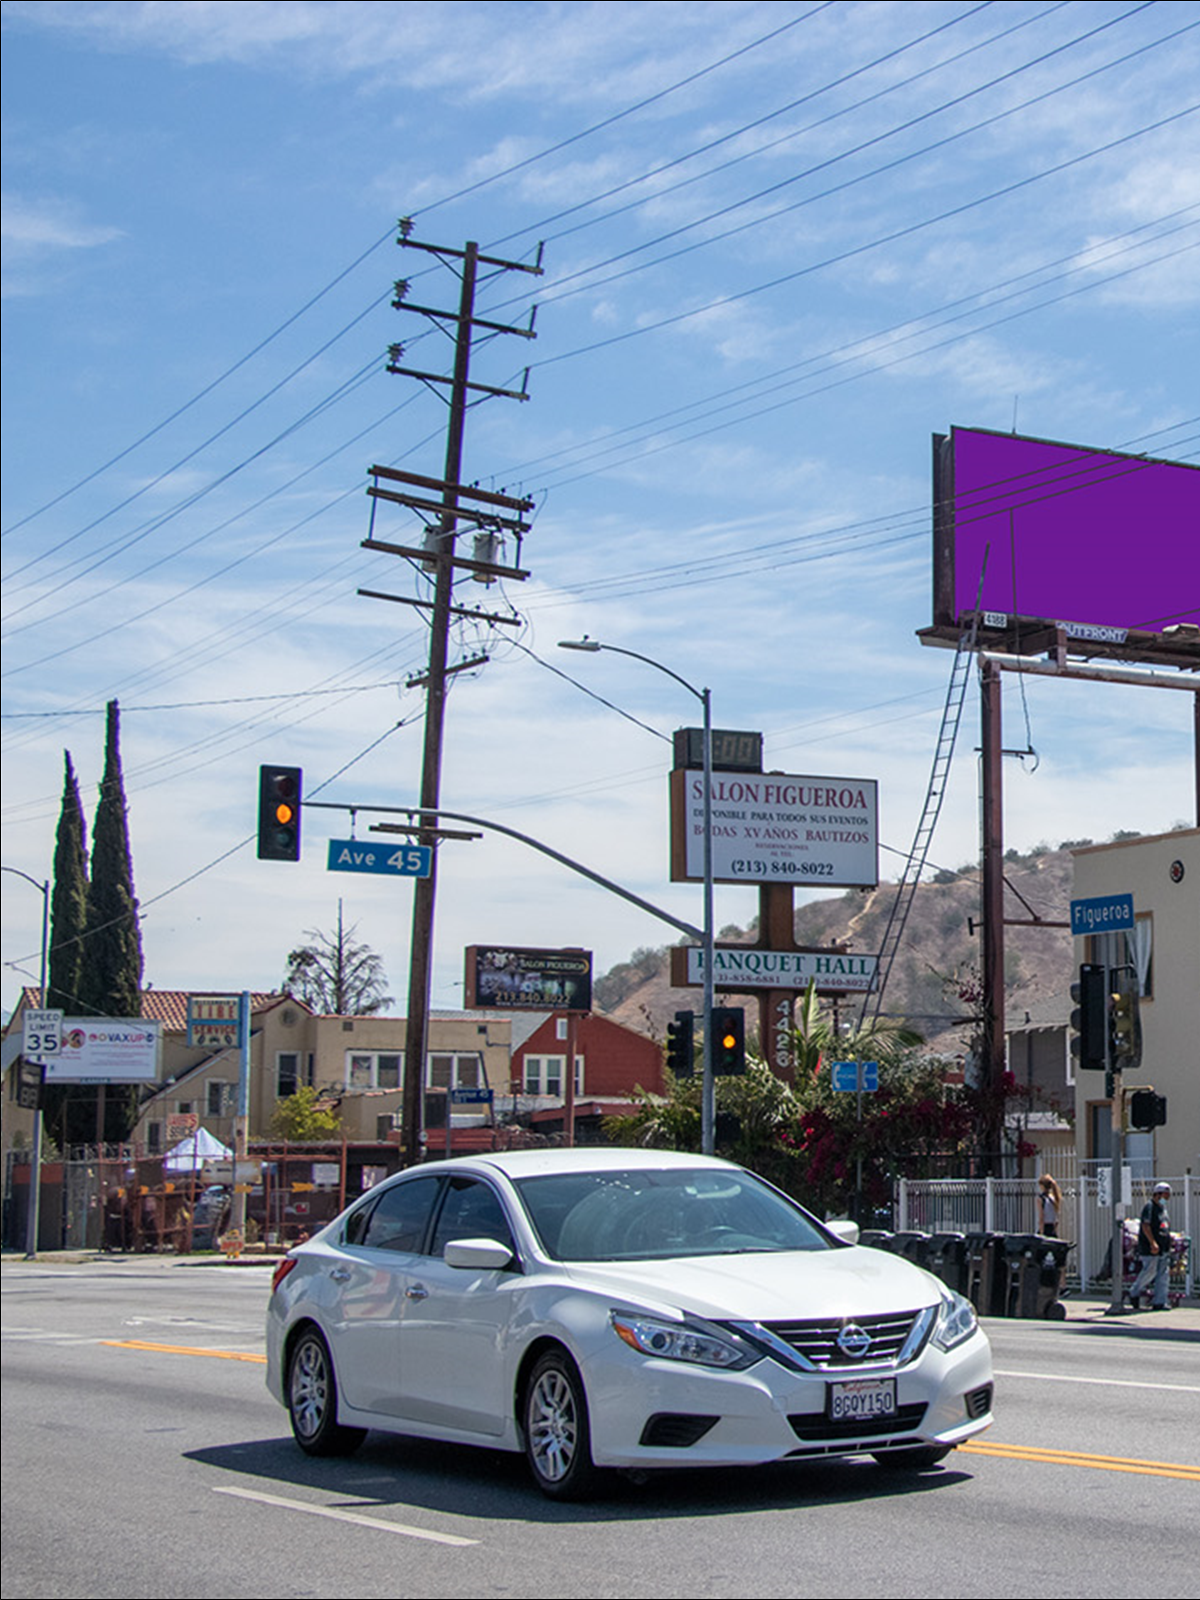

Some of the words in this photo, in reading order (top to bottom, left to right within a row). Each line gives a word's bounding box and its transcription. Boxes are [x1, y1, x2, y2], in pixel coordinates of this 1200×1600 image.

[764, 784, 868, 809] FIGUEROA
[751, 811, 774, 822] PARA
[776, 814, 807, 824] TODOS
[810, 815, 827, 825] SUS
[828, 816, 868, 826] EVENTOS
[693, 824, 737, 837] BDAS
[743, 826, 761, 838] XV
[762, 824, 799, 840] AÑOS
[805, 830, 869, 844] BAUTIZOS
[337, 847, 376, 866] Ave
[387, 850, 422, 872] 45
[731, 859, 767, 875] (213)
[771, 861, 834, 876] 840-8022
[1075, 904, 1130, 929] Figueroa
[520, 959, 546, 969] SALON
[547, 960, 585, 970] FIGUEROA
[816, 957, 871, 975] HALL
[26, 1012, 60, 1021] SPEED
[29, 1024, 56, 1032] LIMIT
[193, 1024, 237, 1035] SERVICE
[27, 1034, 58, 1051] 35
